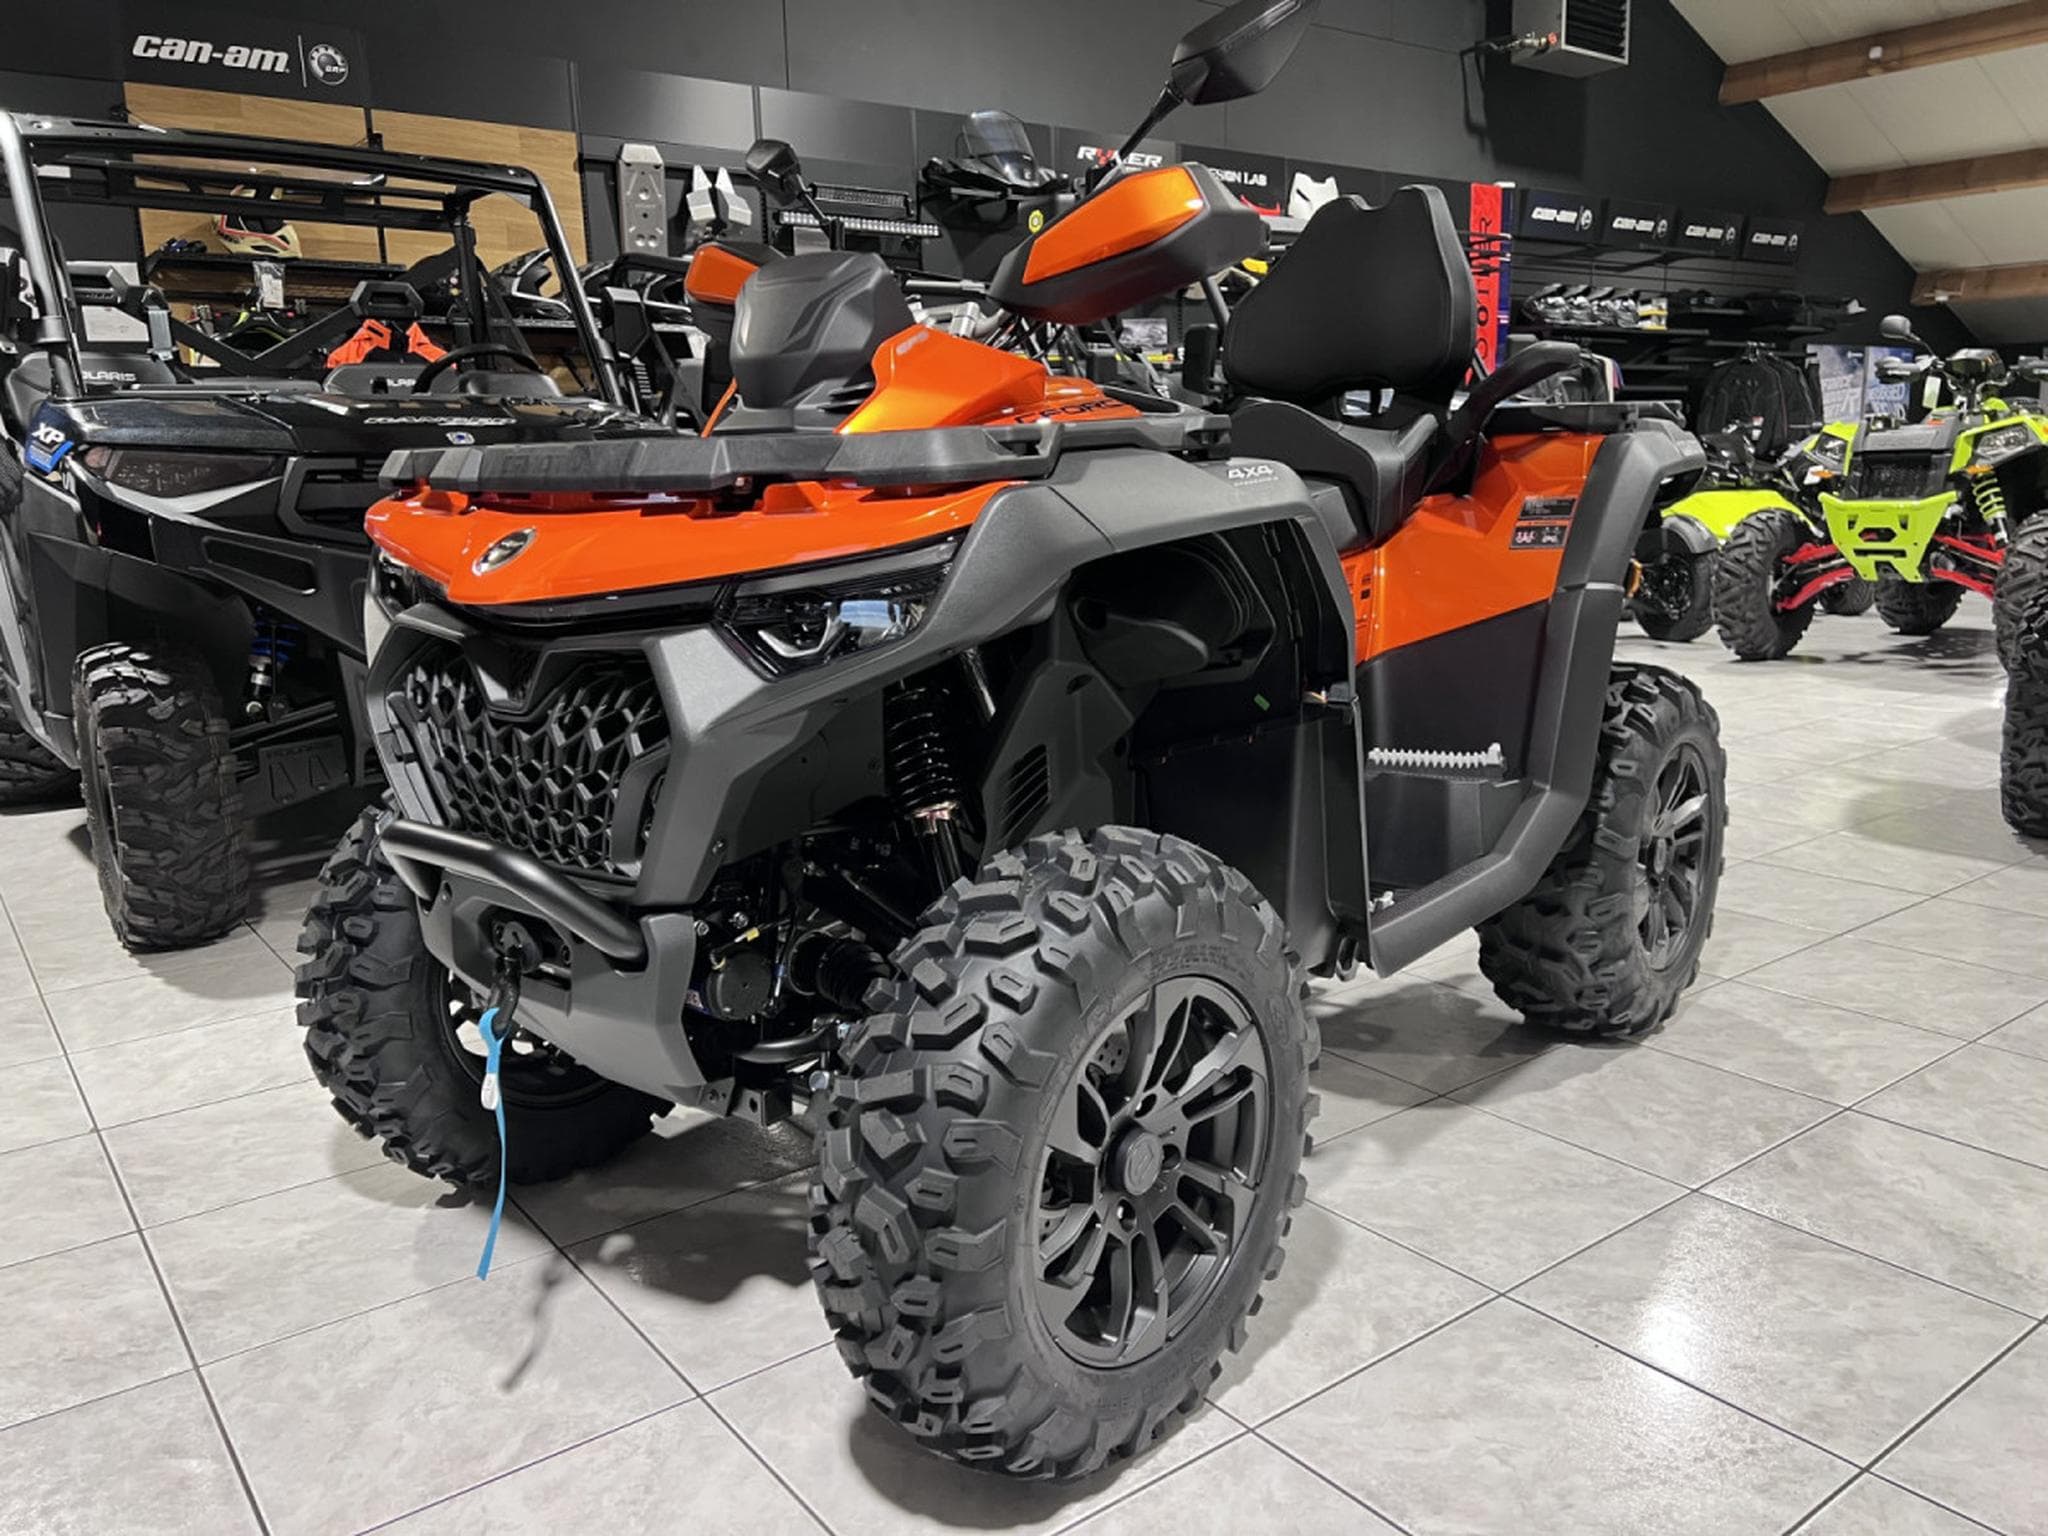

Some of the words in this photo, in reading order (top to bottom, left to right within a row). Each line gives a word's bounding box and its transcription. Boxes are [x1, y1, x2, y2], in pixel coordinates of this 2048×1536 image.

[132, 35, 289, 73] can-am
[1243, 171, 1268, 187] LAB
[31, 422, 66, 444] XP
